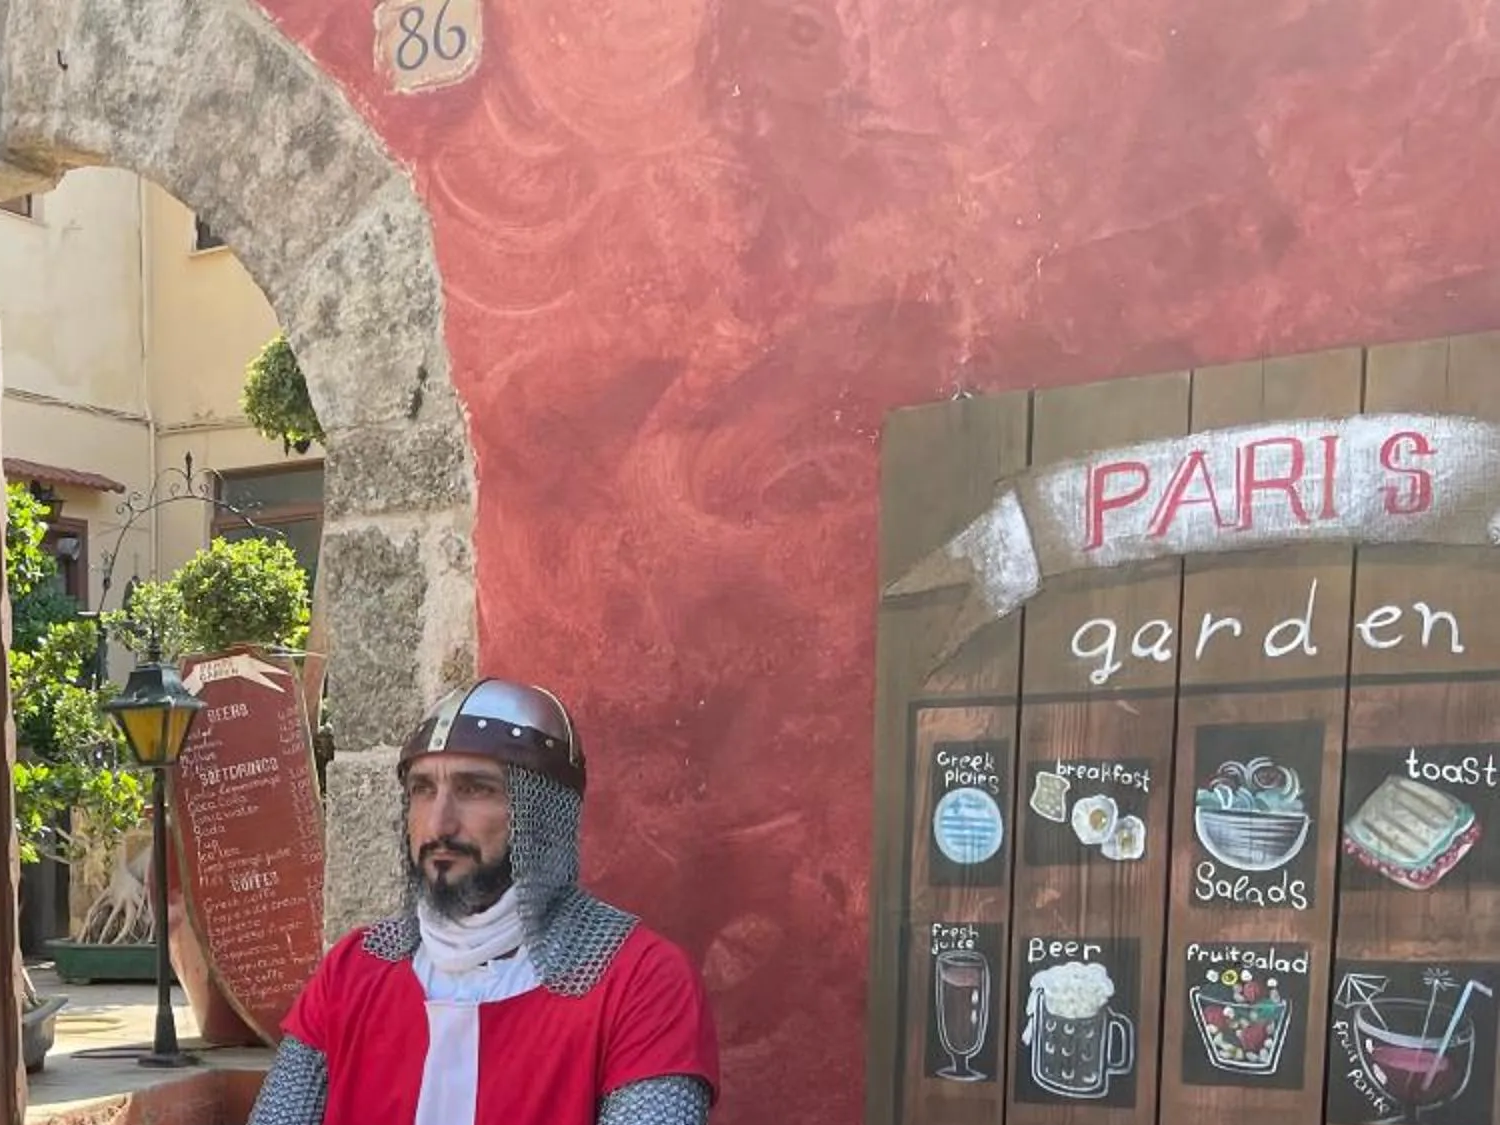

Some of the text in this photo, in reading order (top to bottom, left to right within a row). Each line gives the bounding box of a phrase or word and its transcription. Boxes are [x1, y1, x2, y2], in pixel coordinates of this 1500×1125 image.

[396, 0, 467, 71] 86
[1082, 430, 1438, 552] PARIS
[1070, 578, 1465, 686] garden
[936, 750, 995, 772] Greek
[1055, 756, 1151, 793] breakfast
[1195, 860, 1308, 911] Salads
[1027, 937, 1102, 964] Beer
